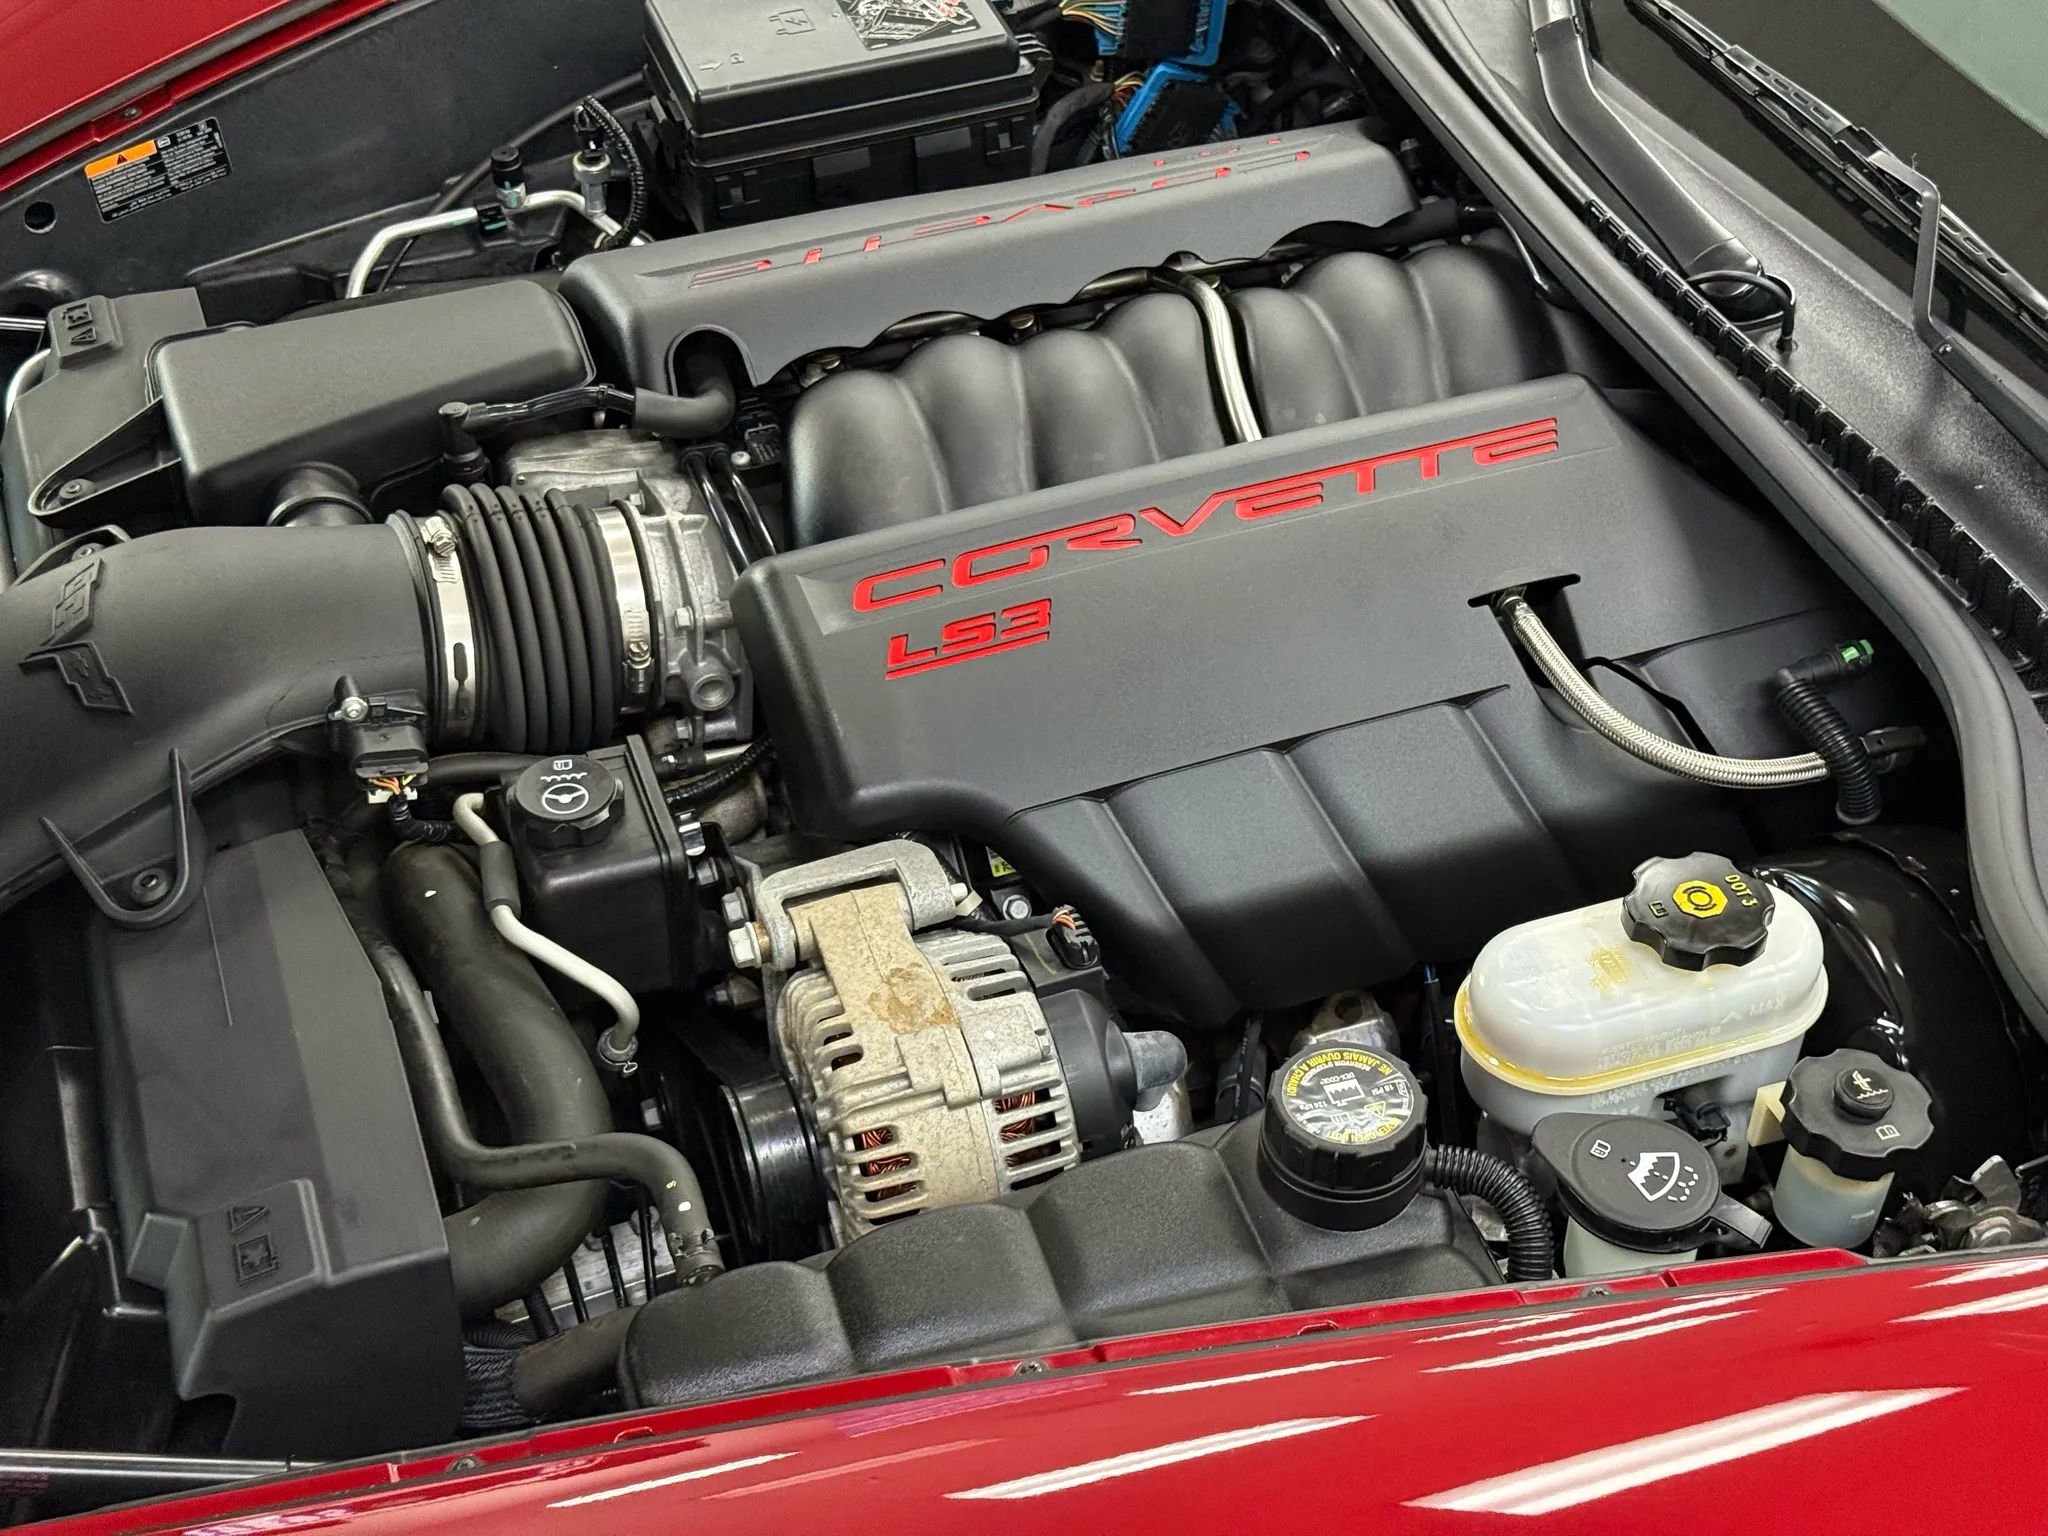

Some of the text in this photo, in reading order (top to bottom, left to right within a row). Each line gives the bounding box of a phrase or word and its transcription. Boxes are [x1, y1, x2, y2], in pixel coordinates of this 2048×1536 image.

[853, 417, 1558, 613] CORVETTE
[886, 598, 1052, 668] LS3
[1725, 875, 1758, 906] DOT 3
[1306, 1053, 1341, 1067] OUVRIR
[1343, 1052, 1380, 1069] JAMAIS
[1379, 1063, 1393, 1076] NE
[1371, 1085, 1385, 1096] PSI
